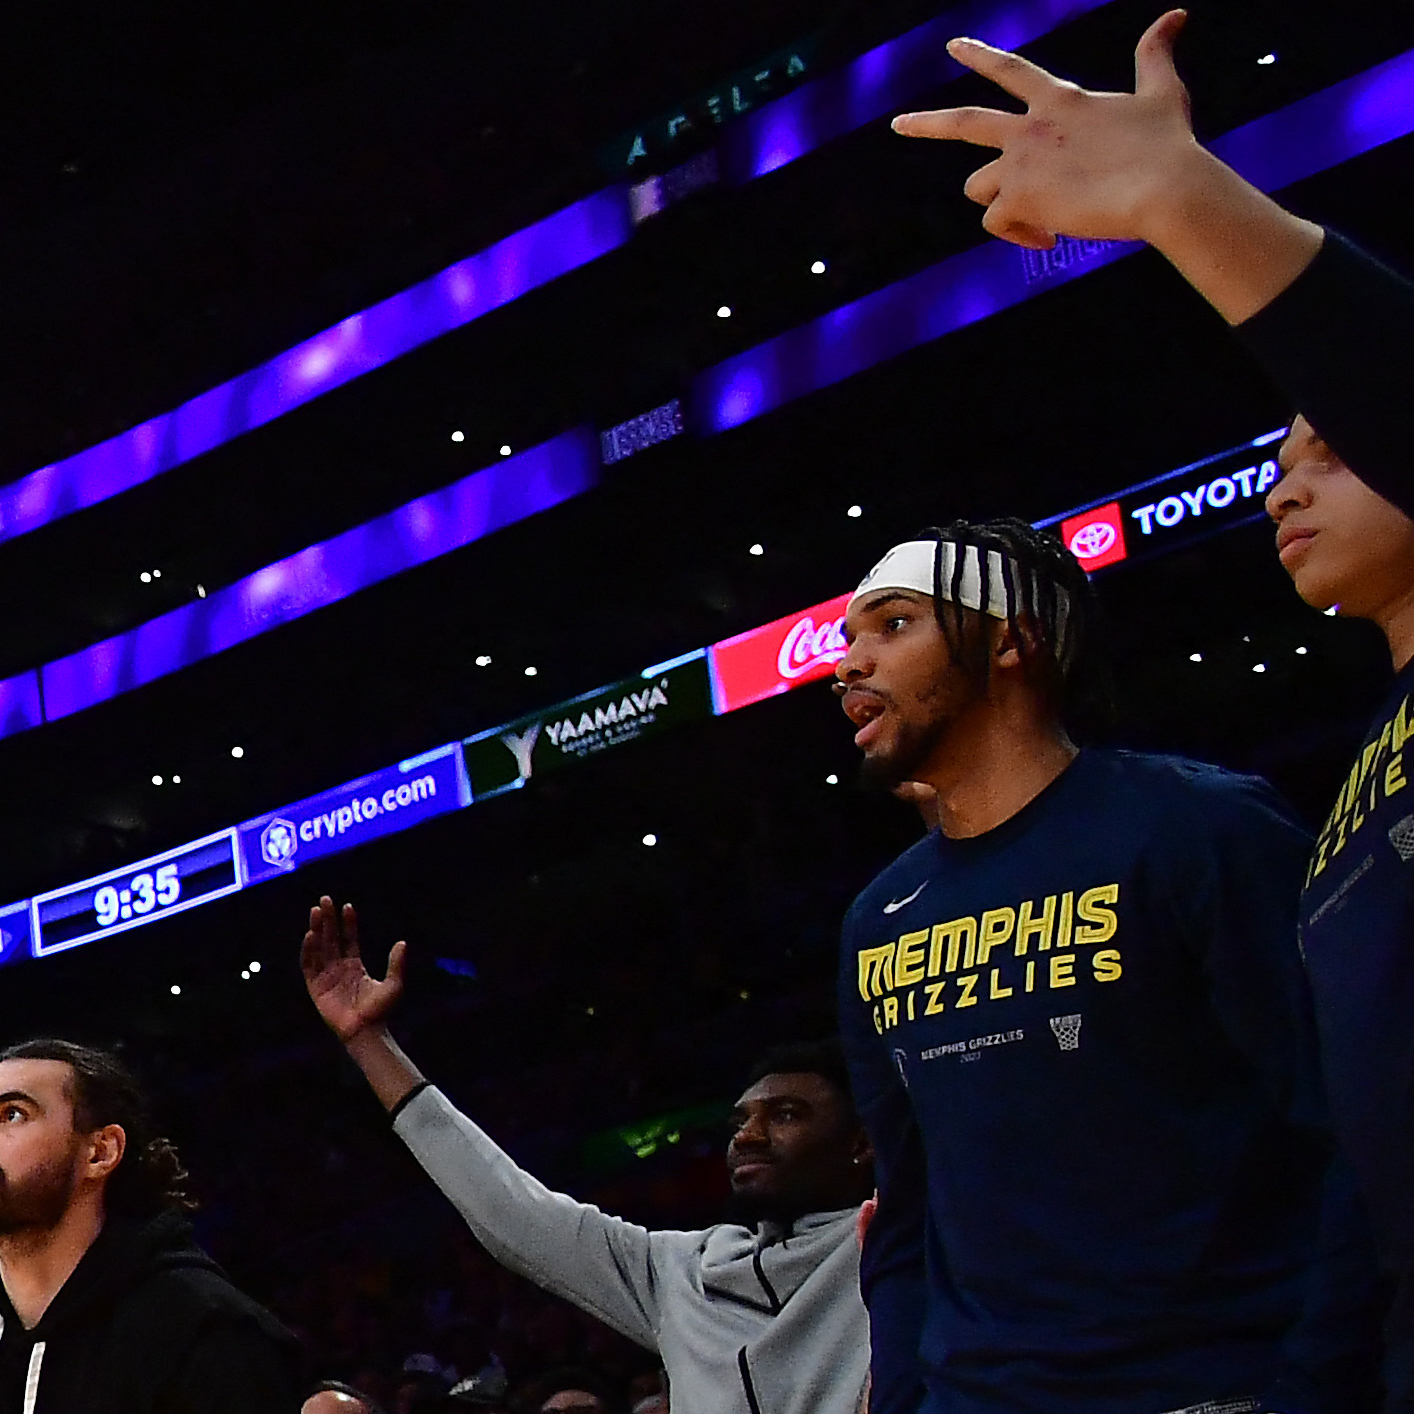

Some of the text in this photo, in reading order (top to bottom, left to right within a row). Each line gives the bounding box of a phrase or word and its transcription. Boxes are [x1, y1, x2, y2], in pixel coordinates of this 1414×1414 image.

[1132, 460, 1280, 535] TOYOTA
[298, 771, 437, 845] crypto.com
[93, 863, 180, 927] 9:35
[858, 883, 1120, 1003] MEMPHIS
[873, 949, 1123, 1036] GRIZZLIES
